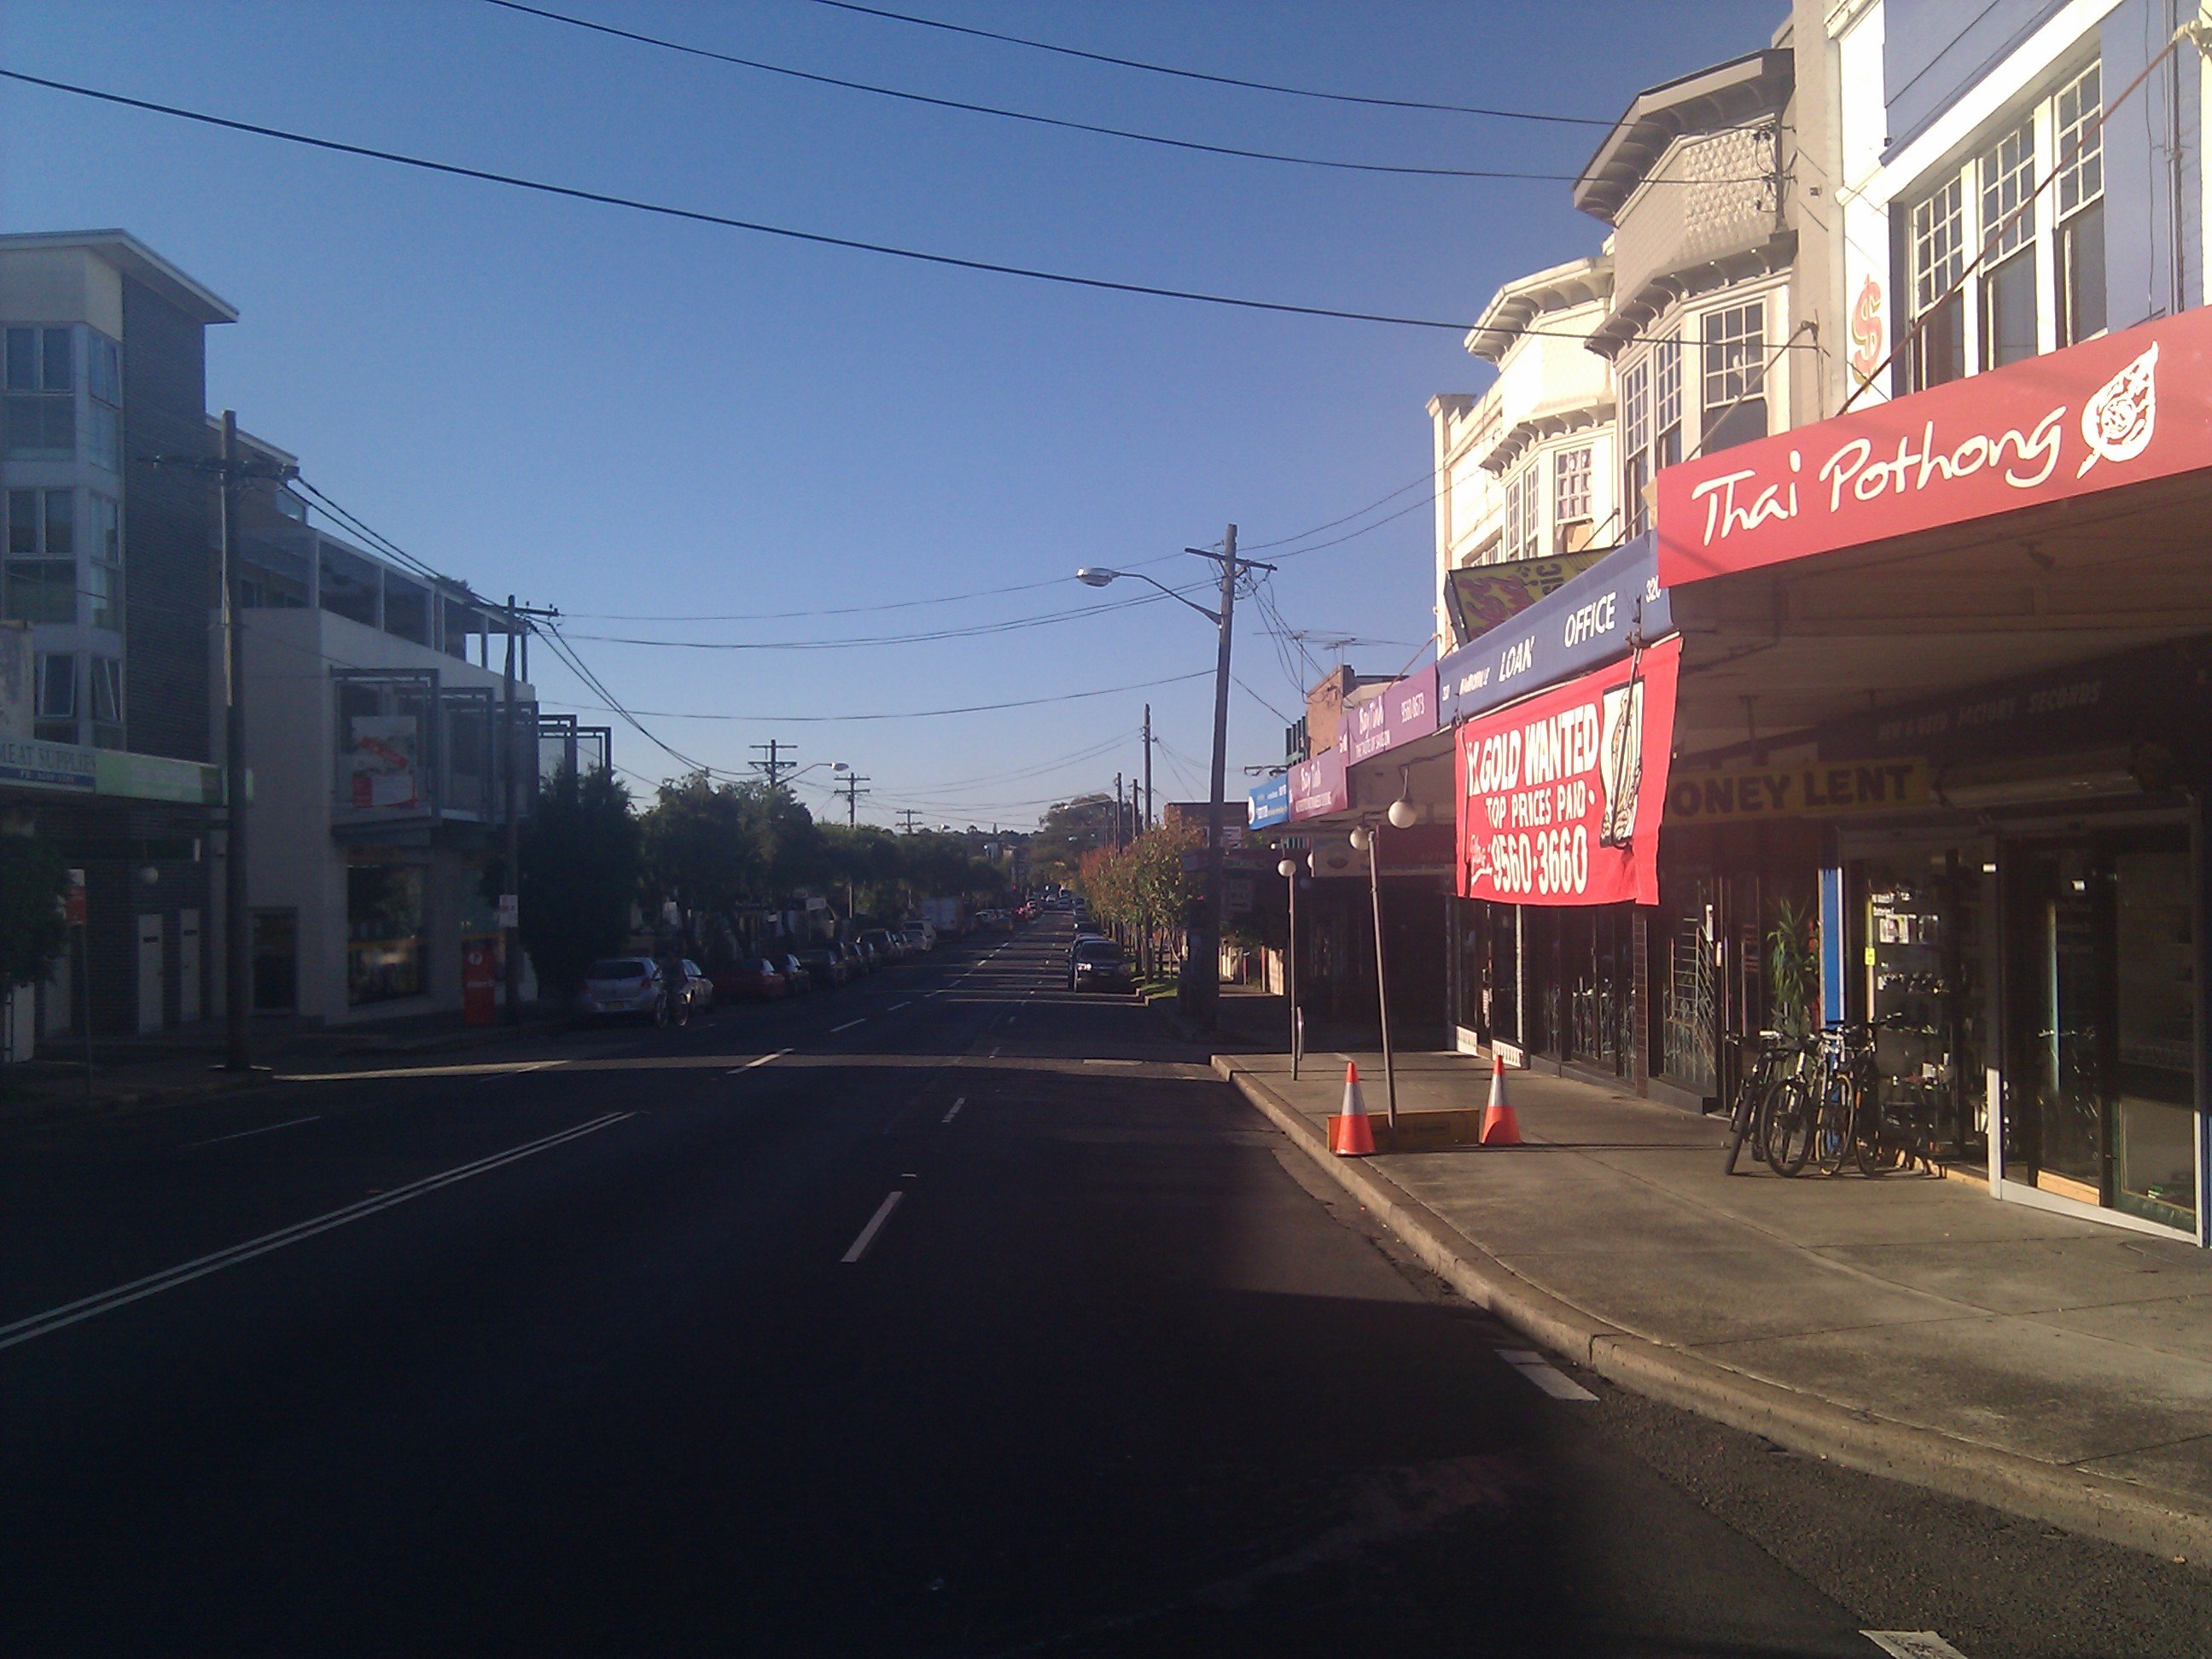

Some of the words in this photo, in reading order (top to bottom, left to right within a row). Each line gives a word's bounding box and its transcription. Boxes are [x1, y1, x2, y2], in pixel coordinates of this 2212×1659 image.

[1691, 450, 1799, 547] Thai
[1819, 405, 2067, 513] Pothong
[1498, 636, 1536, 682] LOAN
[1563, 591, 1617, 648] OFFICE
[2027, 680, 2103, 714] SECONDS
[1480, 729, 1522, 793] GOLD
[1524, 702, 1599, 786] WANTED
[1486, 795, 1507, 829] TOP
[1511, 787, 1551, 829] PRICES
[1557, 780, 1586, 823] PAID
[1670, 772, 1791, 818] ONEY
[1804, 765, 1913, 806] LENT
